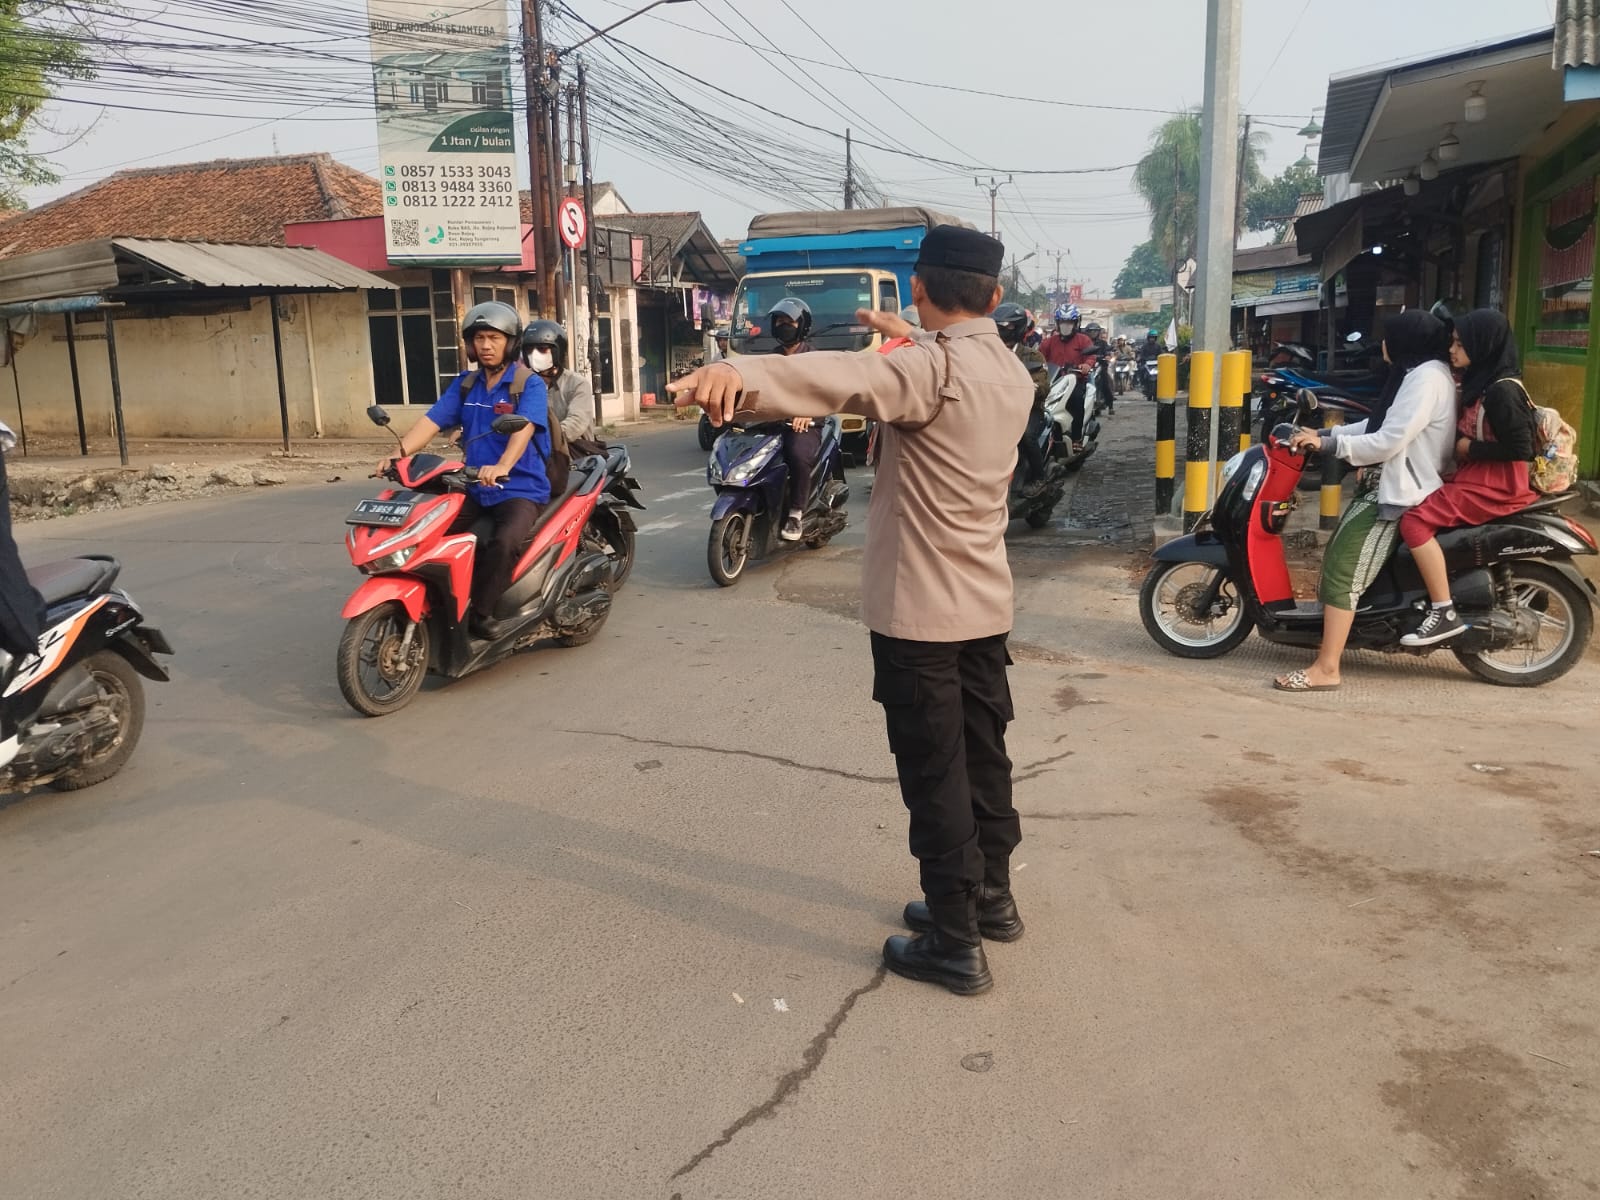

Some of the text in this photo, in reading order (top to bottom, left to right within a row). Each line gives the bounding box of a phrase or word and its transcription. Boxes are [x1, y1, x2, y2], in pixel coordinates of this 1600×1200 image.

[441, 136, 448, 145] 1
[482, 136, 511, 146] bulan
[401, 165, 511, 178] 0857 1533 3043
[402, 181, 512, 193] 0813 9484 3360
[403, 195, 513, 207] 0812 1222 2412
